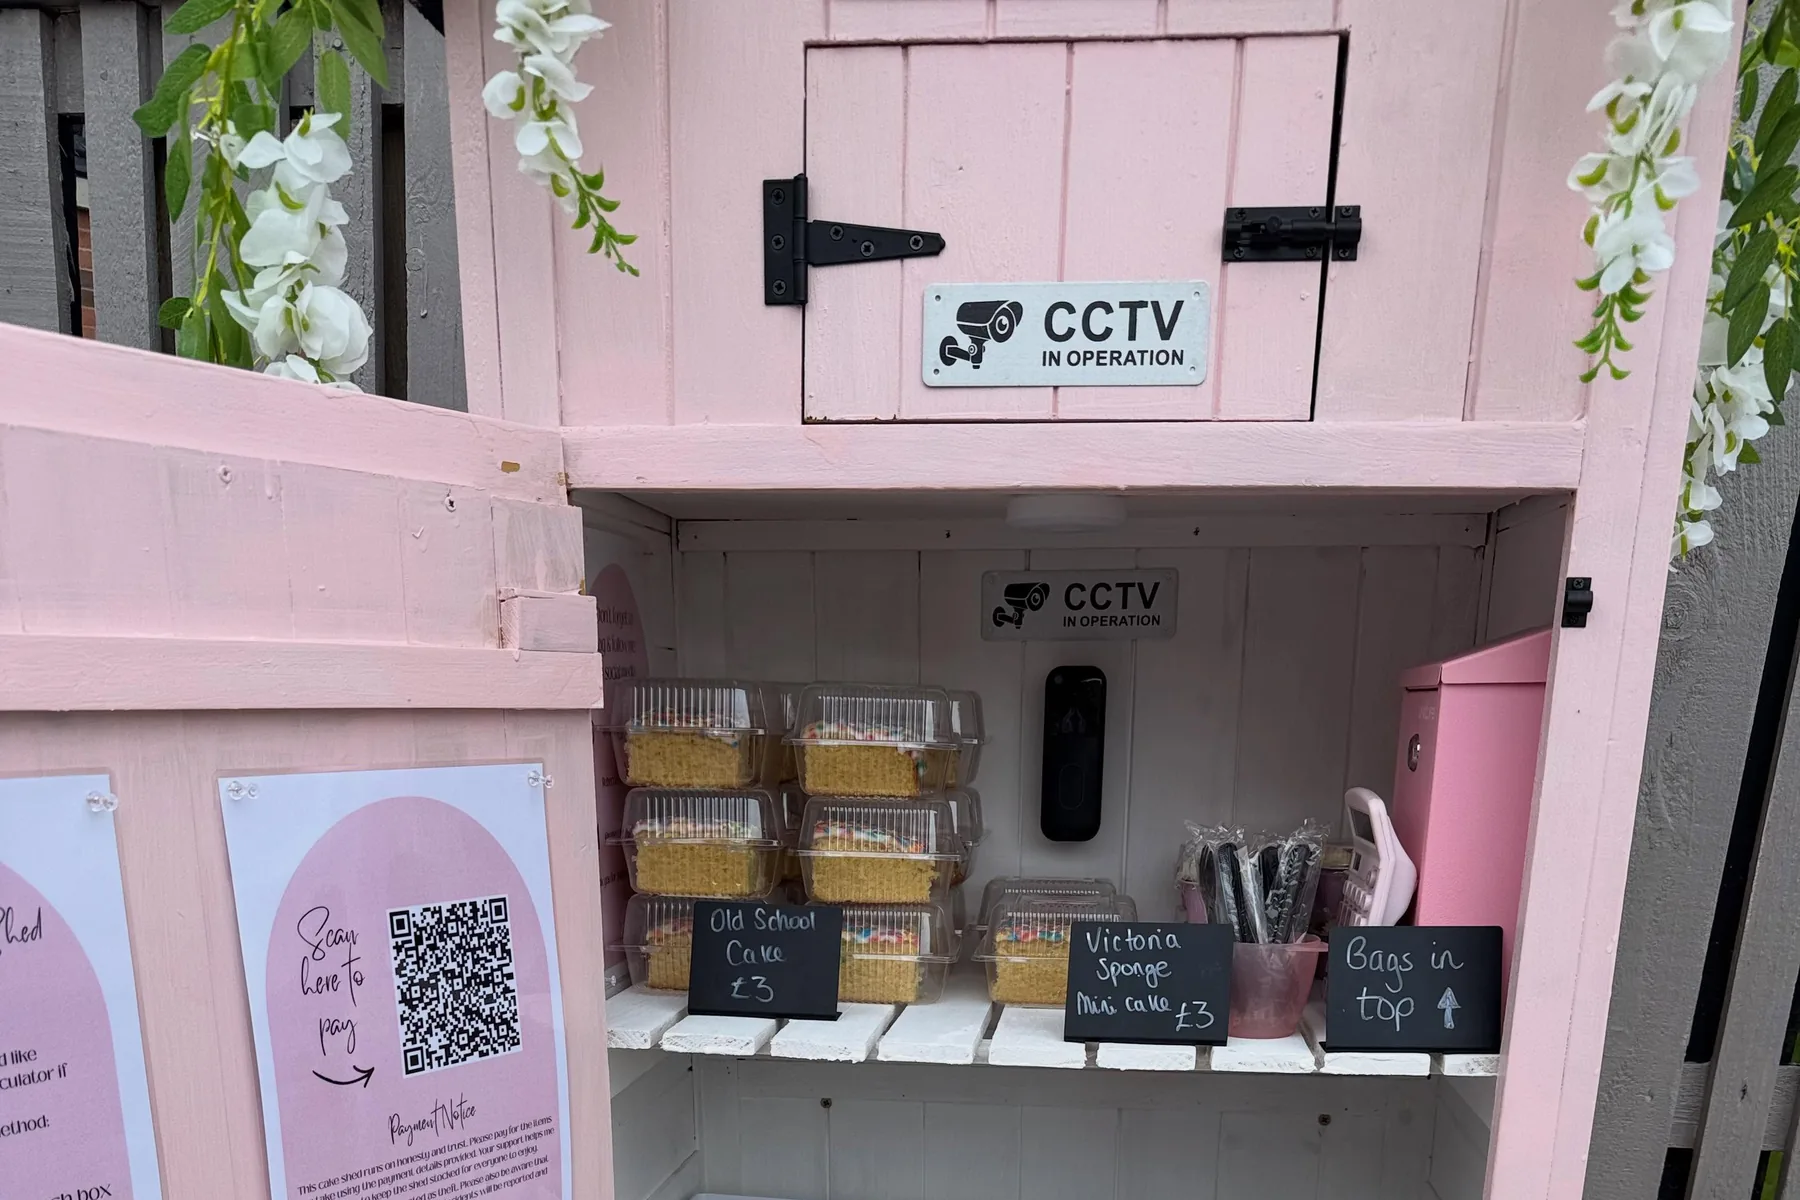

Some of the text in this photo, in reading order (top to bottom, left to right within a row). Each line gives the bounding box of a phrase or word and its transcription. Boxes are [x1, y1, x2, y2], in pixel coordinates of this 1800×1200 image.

[1044, 299, 1184, 342] CCTV
[1042, 349, 1184, 367] IN OPERATION
[1064, 581, 1161, 611] CCTV
[1063, 614, 1161, 628] IN OPERATION
[0, 906, 43, 943] hed
[297, 906, 358, 964] Scan
[711, 908, 816, 932] Old School
[726, 940, 787, 966] Cake
[1086, 927, 1181, 953] Victoria
[301, 944, 365, 1006] here to
[1096, 958, 1172, 988] Sponge
[1346, 936, 1464, 993] Bags in
[731, 976, 774, 1002] £3
[1077, 991, 1117, 1016] Mini
[1176, 1001, 1214, 1031] £3
[1356, 986, 1414, 1032] top
[319, 1018, 356, 1056] pay
[11, 1049, 38, 1065] like
[0, 1115, 50, 1138] ethod:
[389, 1092, 476, 1146] Payment Notice
[298, 1184, 316, 1195] This
[318, 1177, 339, 1189] cake
[341, 1169, 362, 1183] shed
[363, 1164, 383, 1176] runs
[384, 1161, 395, 1170] on
[396, 1151, 430, 1167] honesty
[431, 1145, 446, 1157] and
[469, 1133, 493, 1145] Please
[494, 1129, 507, 1140] pay
[508, 1125, 519, 1134] for
[520, 1122, 532, 1130] the
[337, 1185, 360, 1198] using
[362, 1180, 376, 1190] the
[377, 1168, 414, 1188] payment
[415, 1160, 442, 1174] details
[478, 1145, 495, 1155] Your
[496, 1136, 523, 1150] support
[524, 1131, 543, 1141] helps
[544, 1127, 554, 1136] me
